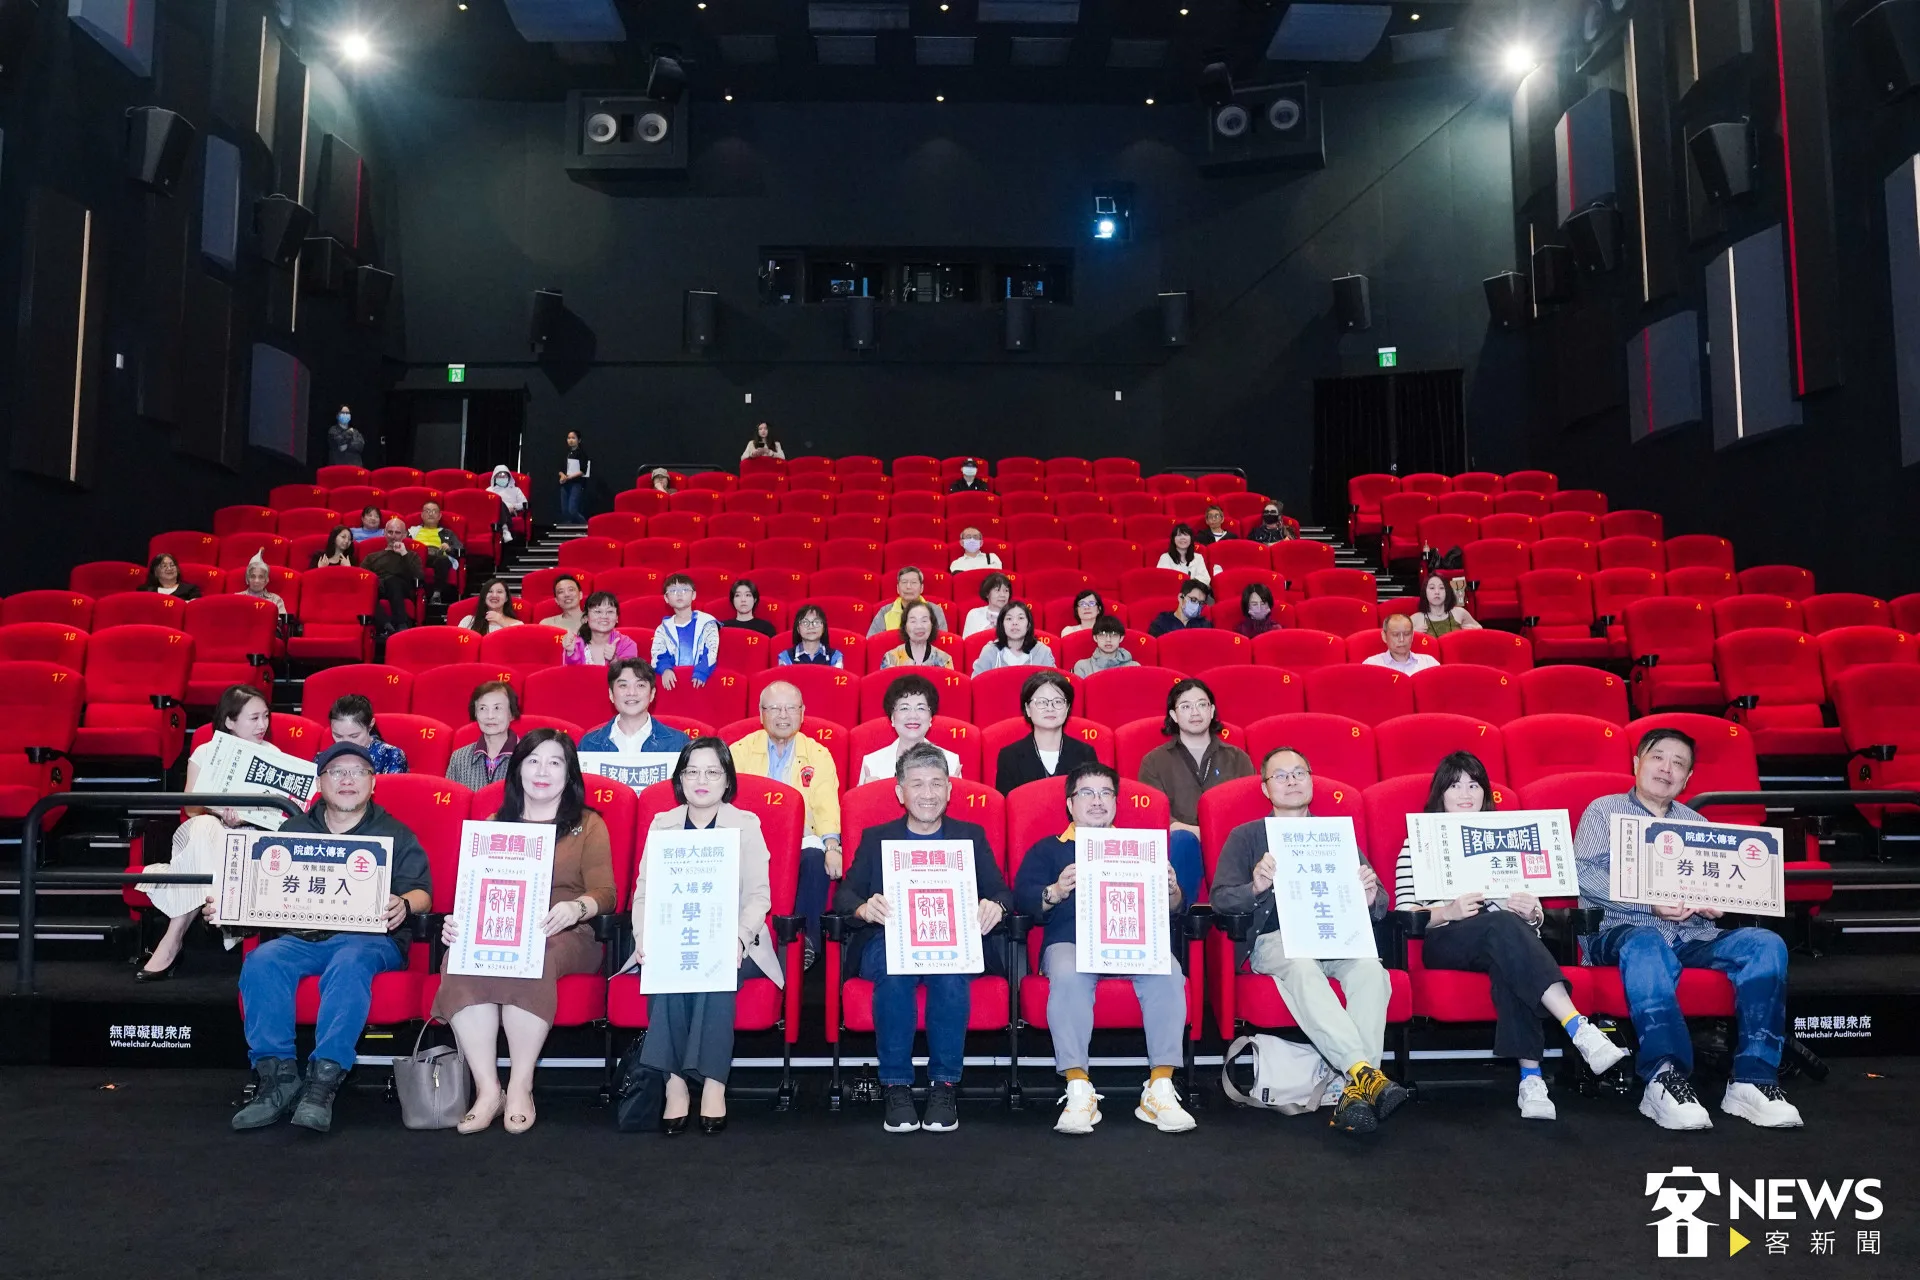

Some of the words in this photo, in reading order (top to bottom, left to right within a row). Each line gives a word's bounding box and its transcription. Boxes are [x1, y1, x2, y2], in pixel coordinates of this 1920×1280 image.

[71, 598, 84, 607] 19
[163, 599, 175, 608] 18
[253, 601, 266, 610] 17
[512, 602, 523, 611] 16
[767, 603, 779, 612] 13
[852, 603, 865, 613] 12
[1111, 603, 1119, 612] 9
[1279, 603, 1287, 612] 7
[1695, 602, 1702, 611] 4
[1785, 600, 1792, 609] 3
[1872, 600, 1880, 609] 2
[1361, 604, 1368, 614] 6
[63, 631, 77, 641] 18
[168, 634, 182, 644] 17
[457, 634, 470, 644] 16
[746, 636, 759, 646] 13
[843, 635, 856, 646] 12
[940, 634, 954, 645] 11
[1038, 636, 1051, 645] 10
[1139, 636, 1147, 645] 9
[1233, 635, 1241, 645] 8
[1327, 634, 1335, 645] 7
[1421, 636, 1428, 645] 6
[1798, 635, 1806, 644] 4
[1897, 633, 1906, 643] 3
[1514, 637, 1522, 647] 5
[51, 672, 68, 683] 17
[386, 674, 400, 685] 16
[496, 673, 511, 683] 15
[720, 676, 735, 687] 13
[833, 675, 849, 686] 12
[944, 676, 960, 687] 11
[1282, 674, 1291, 685] 8
[1391, 673, 1400, 684] 7
[1499, 675, 1508, 686] 6
[1605, 676, 1614, 687] 5
[288, 726, 304, 738] 16
[419, 727, 437, 740] 15
[816, 728, 833, 740] 12
[949, 727, 967, 739] 11
[1081, 728, 1098, 741] 10
[1221, 728, 1230, 740] 9
[1351, 726, 1361, 738] 8
[1477, 724, 1489, 737] 7
[1604, 726, 1614, 739] 6
[1729, 725, 1739, 737] 5
[254, 762, 305, 796] 客傳大戲院
[608, 766, 659, 785] 客傳大戲院
[433, 791, 452, 806] 14
[593, 788, 614, 804] 13
[763, 791, 784, 806] 12
[966, 793, 987, 808] 11
[1130, 794, 1151, 809] 10
[1333, 790, 1344, 804] 9
[1492, 790, 1503, 804] 8
[1282, 831, 1341, 843] 客傳大戲院
[1471, 827, 1532, 851] 客傳大戲院
[663, 845, 725, 859] 客傳大戲院
[1745, 844, 1762, 861] 全
[354, 856, 369, 873] 全
[1490, 855, 1518, 869] 全票
[1297, 863, 1336, 874] 入場券
[671, 881, 714, 894] 入場券
[1310, 880, 1337, 939] 學生票
[680, 902, 701, 971] 學生票
[1795, 1030, 1833, 1039] Wheelchair
[1834, 1030, 1872, 1038] Auditorium
[110, 1040, 150, 1048] Wheelchair
